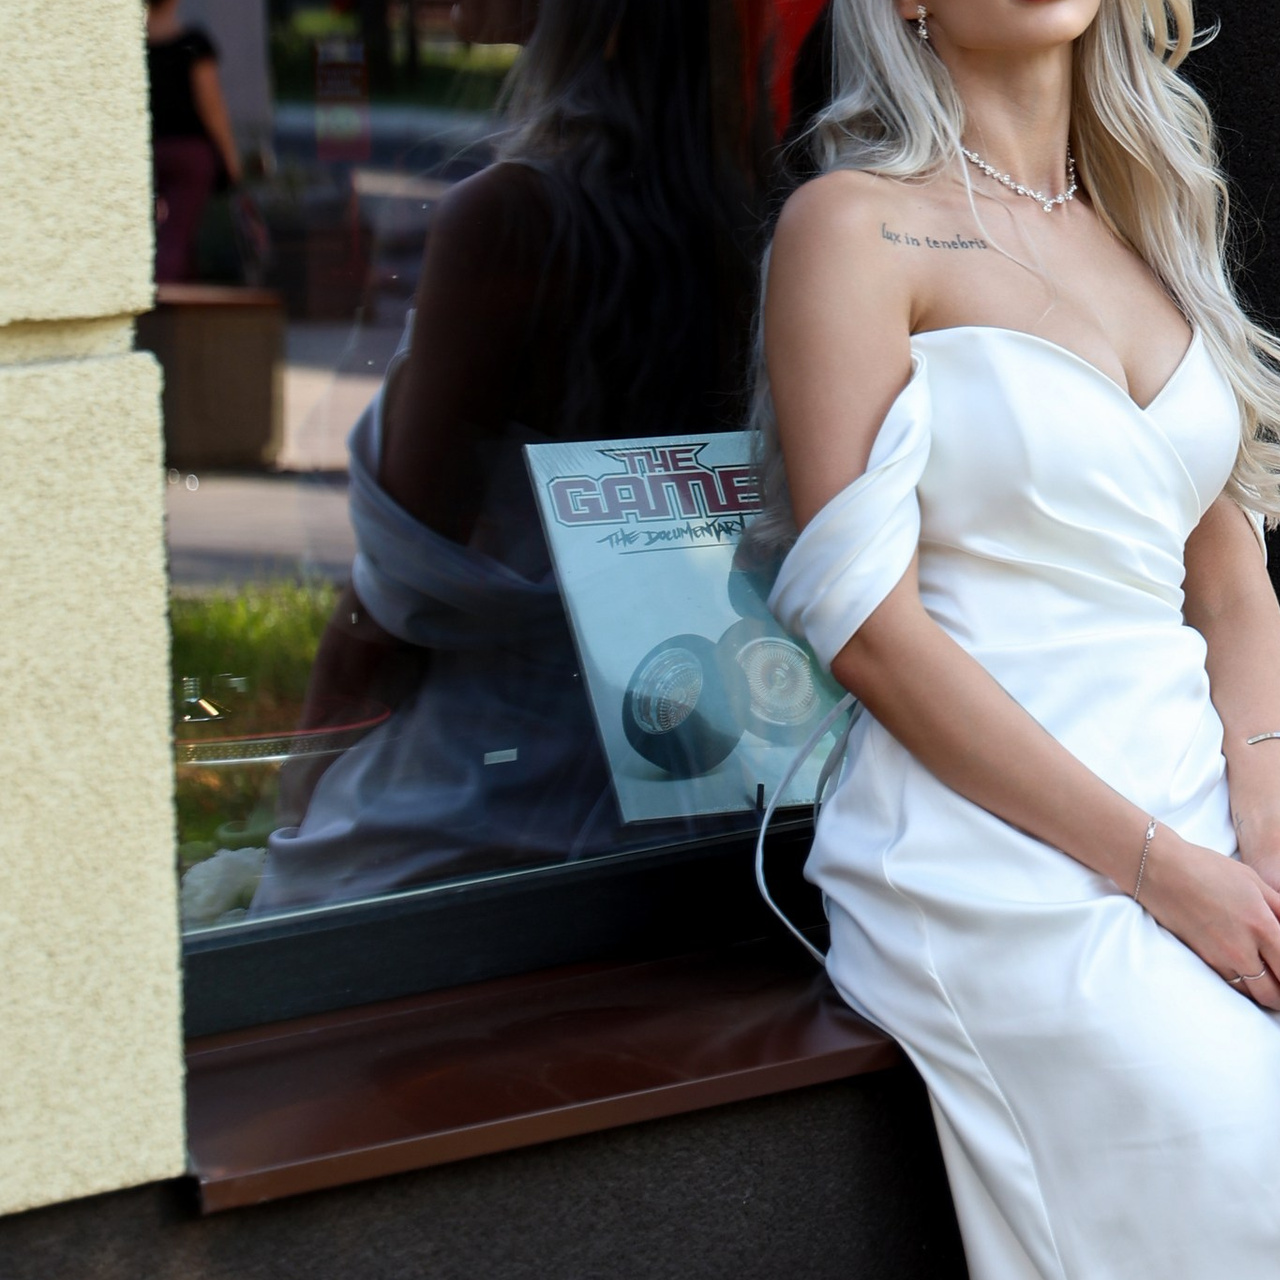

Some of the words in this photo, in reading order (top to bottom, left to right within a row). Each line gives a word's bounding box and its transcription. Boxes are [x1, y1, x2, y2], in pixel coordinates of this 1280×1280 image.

[904, 233, 920, 246] in
[925, 234, 987, 249] tenebris
[597, 443, 709, 475] THE
[547, 464, 763, 527] GAME
[596, 528, 638, 549] THE
